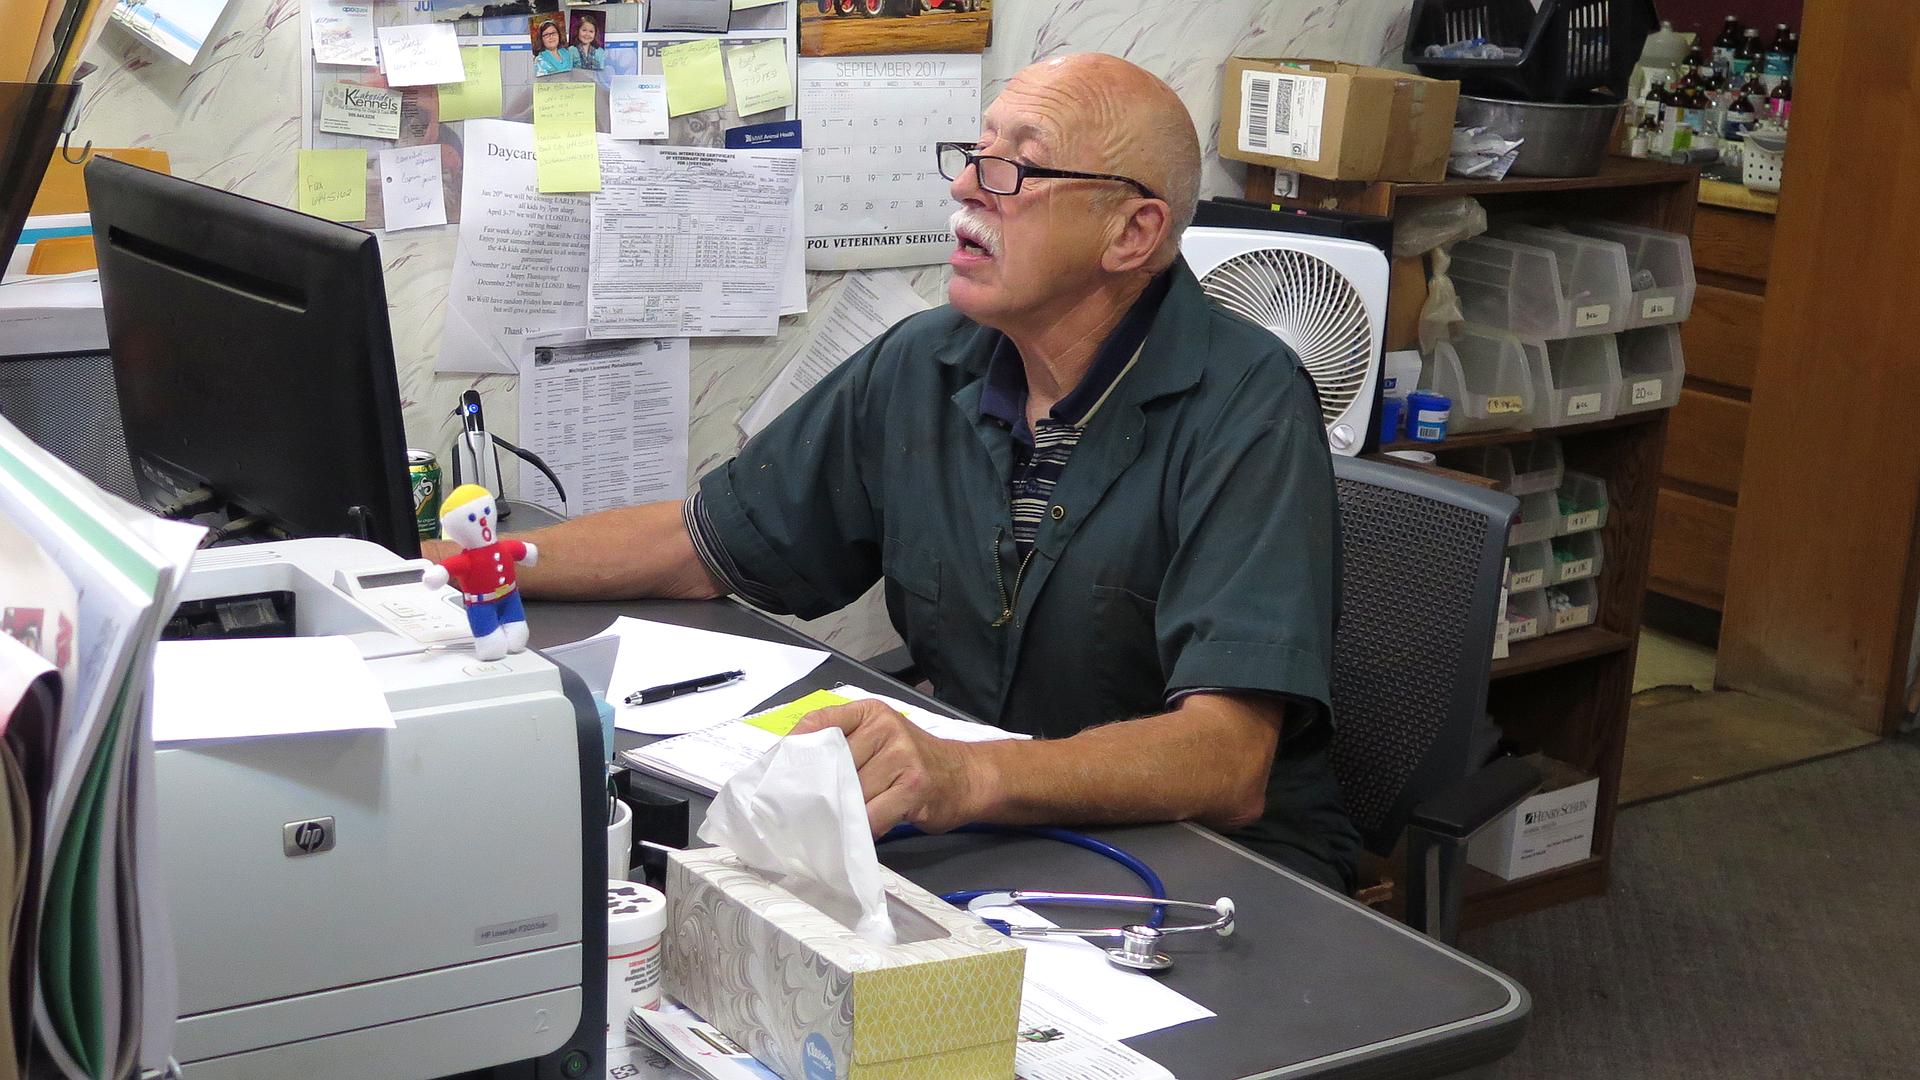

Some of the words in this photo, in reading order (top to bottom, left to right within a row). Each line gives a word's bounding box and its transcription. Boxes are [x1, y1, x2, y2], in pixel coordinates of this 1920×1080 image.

[836, 62, 911, 77] SEPTEMBER
[915, 61, 946, 77] 2017
[345, 88, 398, 111] Kennels
[972, 90, 977, 98] 2
[821, 120, 827, 128] 3
[848, 119, 853, 127] 4
[873, 119, 879, 127] 5
[898, 118, 904, 127] 6
[947, 117, 953, 125] 8
[970, 116, 976, 124] 9
[817, 147, 826, 156] 10
[843, 146, 852, 155] 11
[869, 146, 878, 154] 12
[894, 145, 902, 153] 13
[919, 145, 927, 153] 14
[816, 175, 825, 184] 17
[842, 174, 851, 183] 18
[868, 173, 876, 182] 19
[892, 173, 901, 181] 20
[916, 172, 925, 181] 21
[814, 204, 824, 212] 24
[840, 203, 849, 211] 25
[865, 202, 874, 210] 26
[890, 201, 899, 209] 27
[915, 200, 924, 209] 28
[939, 199, 948, 207] 29
[807, 239, 829, 249] POL
[833, 234, 901, 248] VETERINARY
[478, 279, 505, 287] December
[504, 326, 522, 335] Thank
[492, 927, 518, 937] LaserJet
[534, 1008, 550, 1034] 2
[806, 1041, 833, 1072] Kleenex
